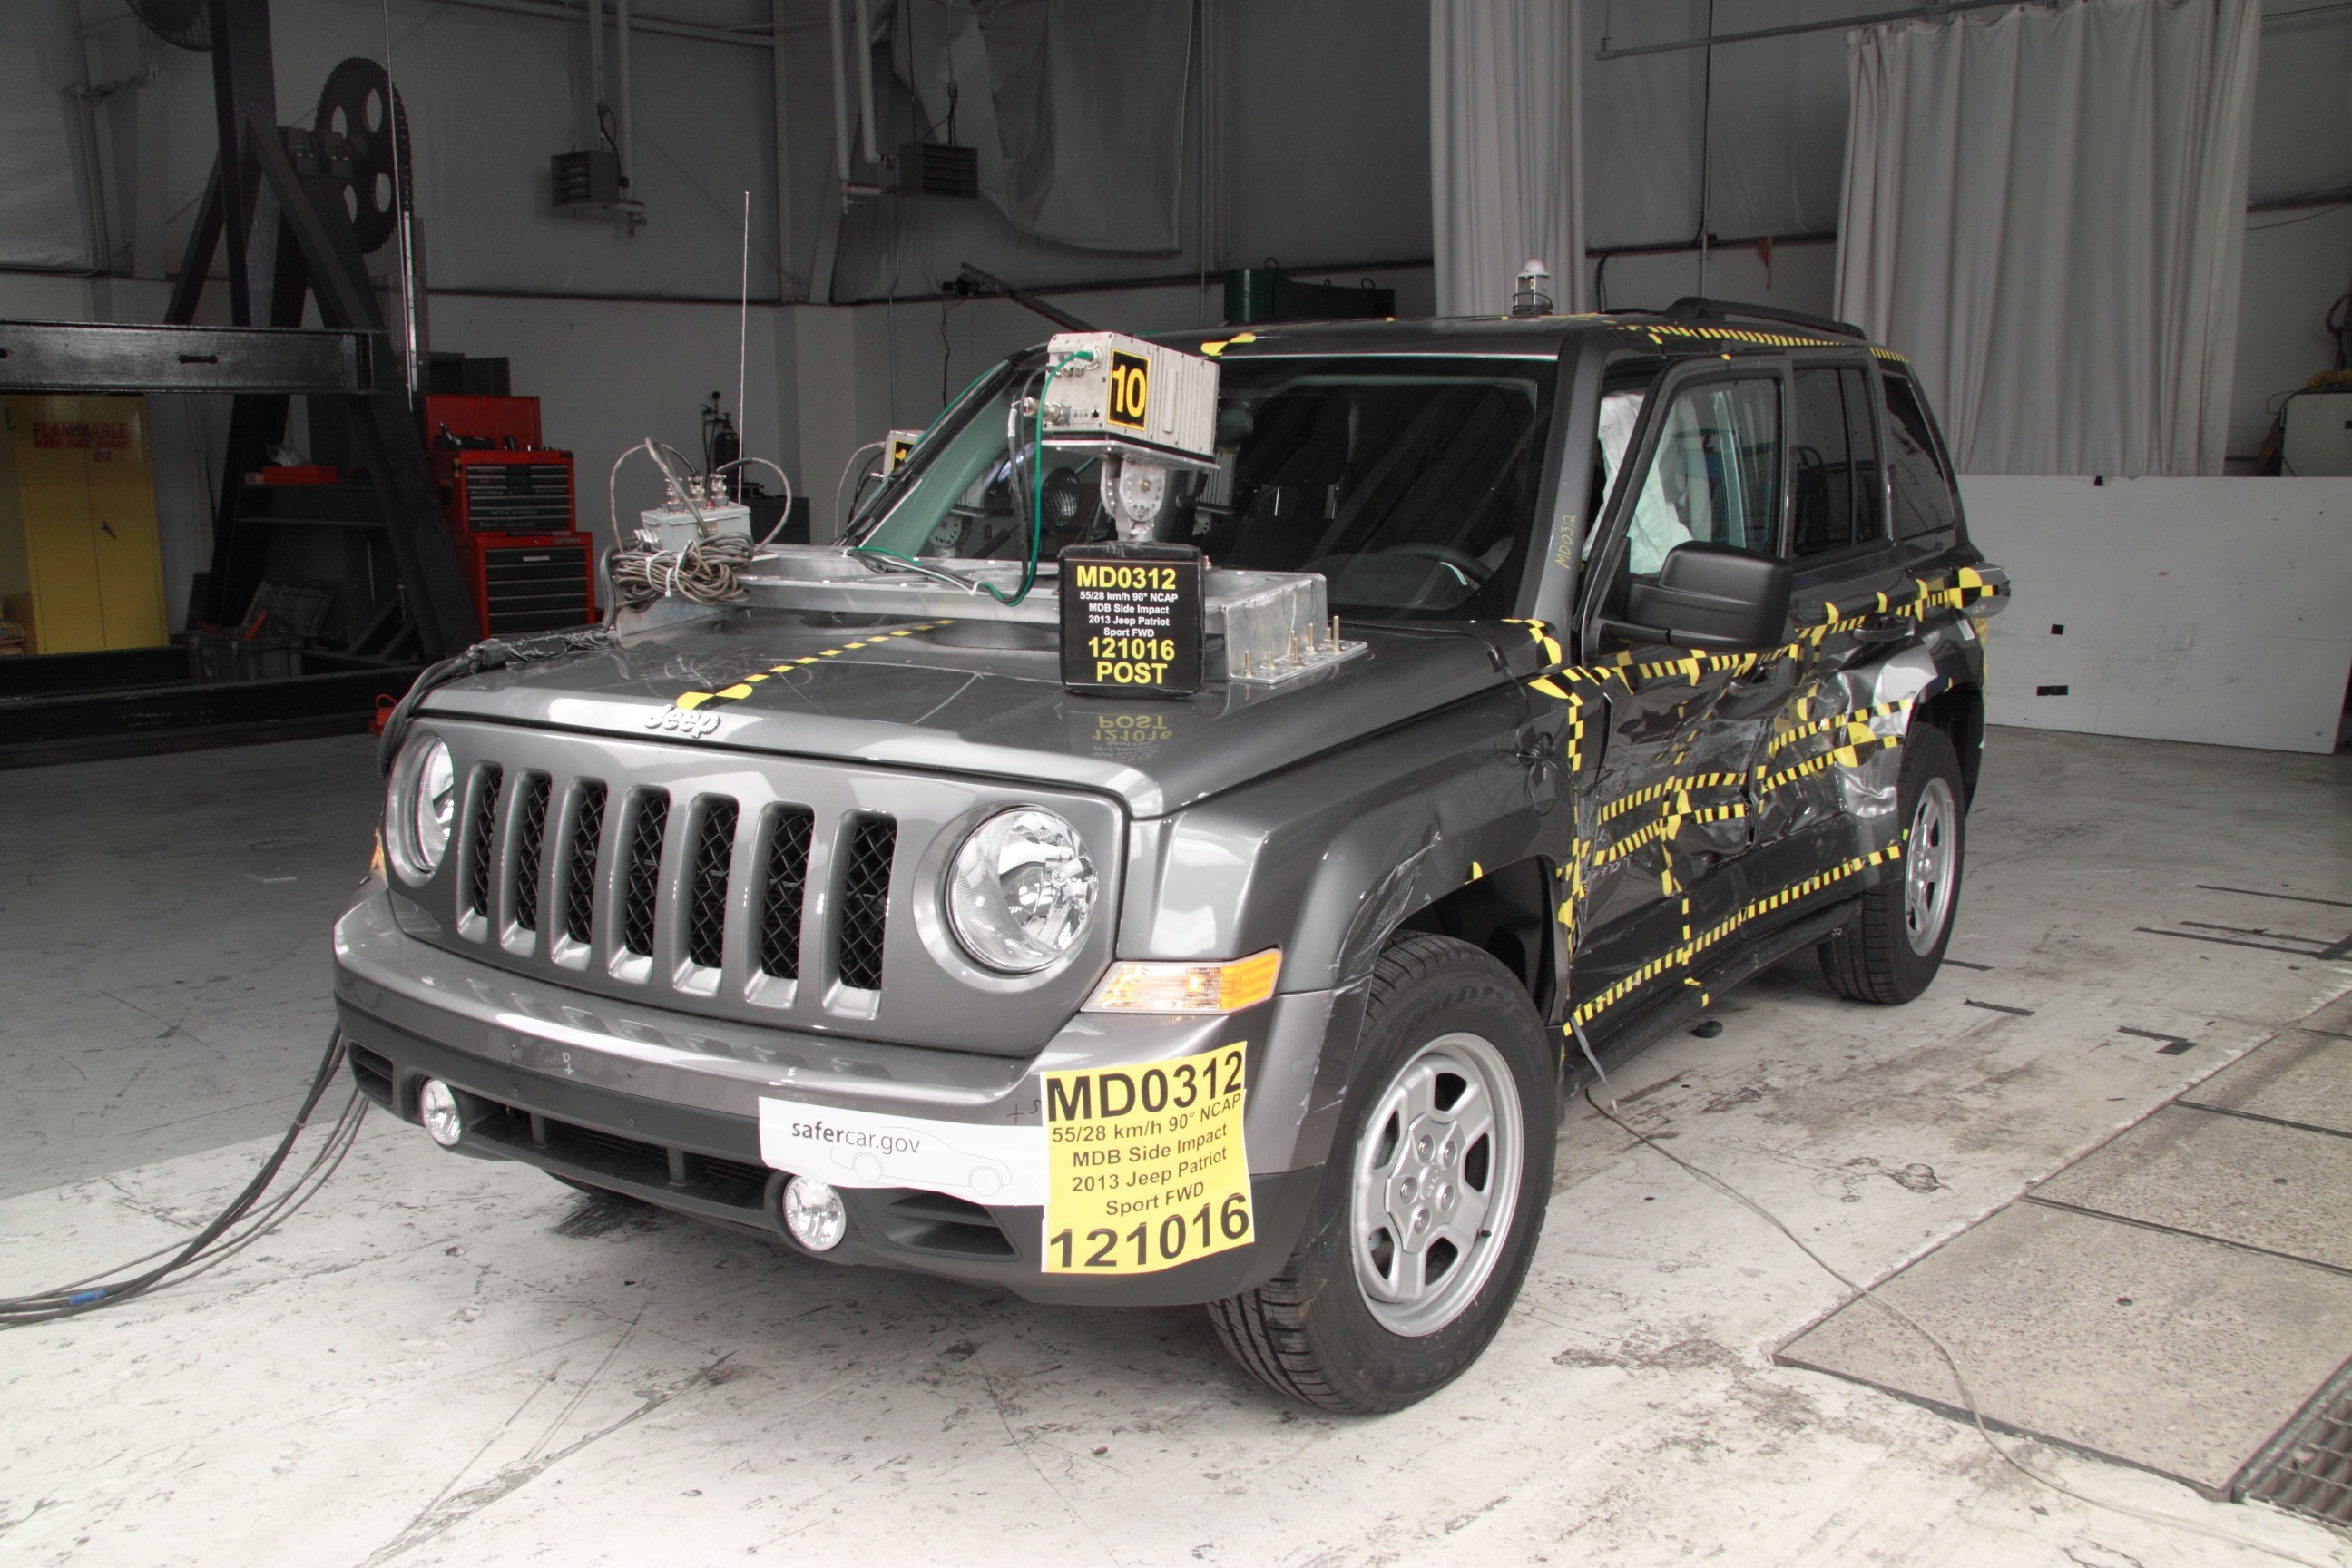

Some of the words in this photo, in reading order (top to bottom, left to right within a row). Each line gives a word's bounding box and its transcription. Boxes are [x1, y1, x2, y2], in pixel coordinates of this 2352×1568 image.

[1112, 364, 1146, 417] 10
[35, 439, 62, 448] KEEP
[67, 439, 92, 448] FIRE
[96, 439, 130, 449] AWAY
[1554, 515, 1576, 569] MD0312
[1076, 565, 1176, 590] MD0312
[1080, 591, 1105, 601] 55/28
[1107, 592, 1131, 602] km/h
[1132, 592, 1148, 602] 90°
[1150, 593, 1179, 603] NCAP
[1089, 603, 1112, 612] MDB
[1113, 603, 1135, 613] Side
[1137, 604, 1170, 615] Impact
[1088, 614, 1111, 624] 2013
[1112, 615, 1136, 627] Jeep
[1138, 616, 1170, 627] Patriot
[1103, 627, 1130, 637] Sport
[1132, 628, 1155, 638] FWD
[1088, 636, 1175, 661] 121016
[1096, 661, 1168, 684] POST
[644, 704, 721, 739] Jeep
[563, 1052, 571, 1063] D
[1046, 1050, 1243, 1122] MD0312
[1053, 1125, 1106, 1143] 55/28
[1114, 1121, 1162, 1140] km/h
[1169, 1111, 1194, 1132] 90°
[1200, 1093, 1242, 1122] NCAP
[792, 1121, 922, 1155] safercar.gov
[1073, 1149, 1122, 1168] MDB
[1129, 1144, 1171, 1163] Side
[1177, 1123, 1228, 1154] Impact
[1072, 1174, 1120, 1192] 2013
[1126, 1169, 1172, 1188] Jeep
[1178, 1146, 1228, 1178] Patriot
[1106, 1194, 1160, 1218] Sport
[1165, 1181, 1205, 1206] FWD
[1050, 1192, 1250, 1269] 121016
